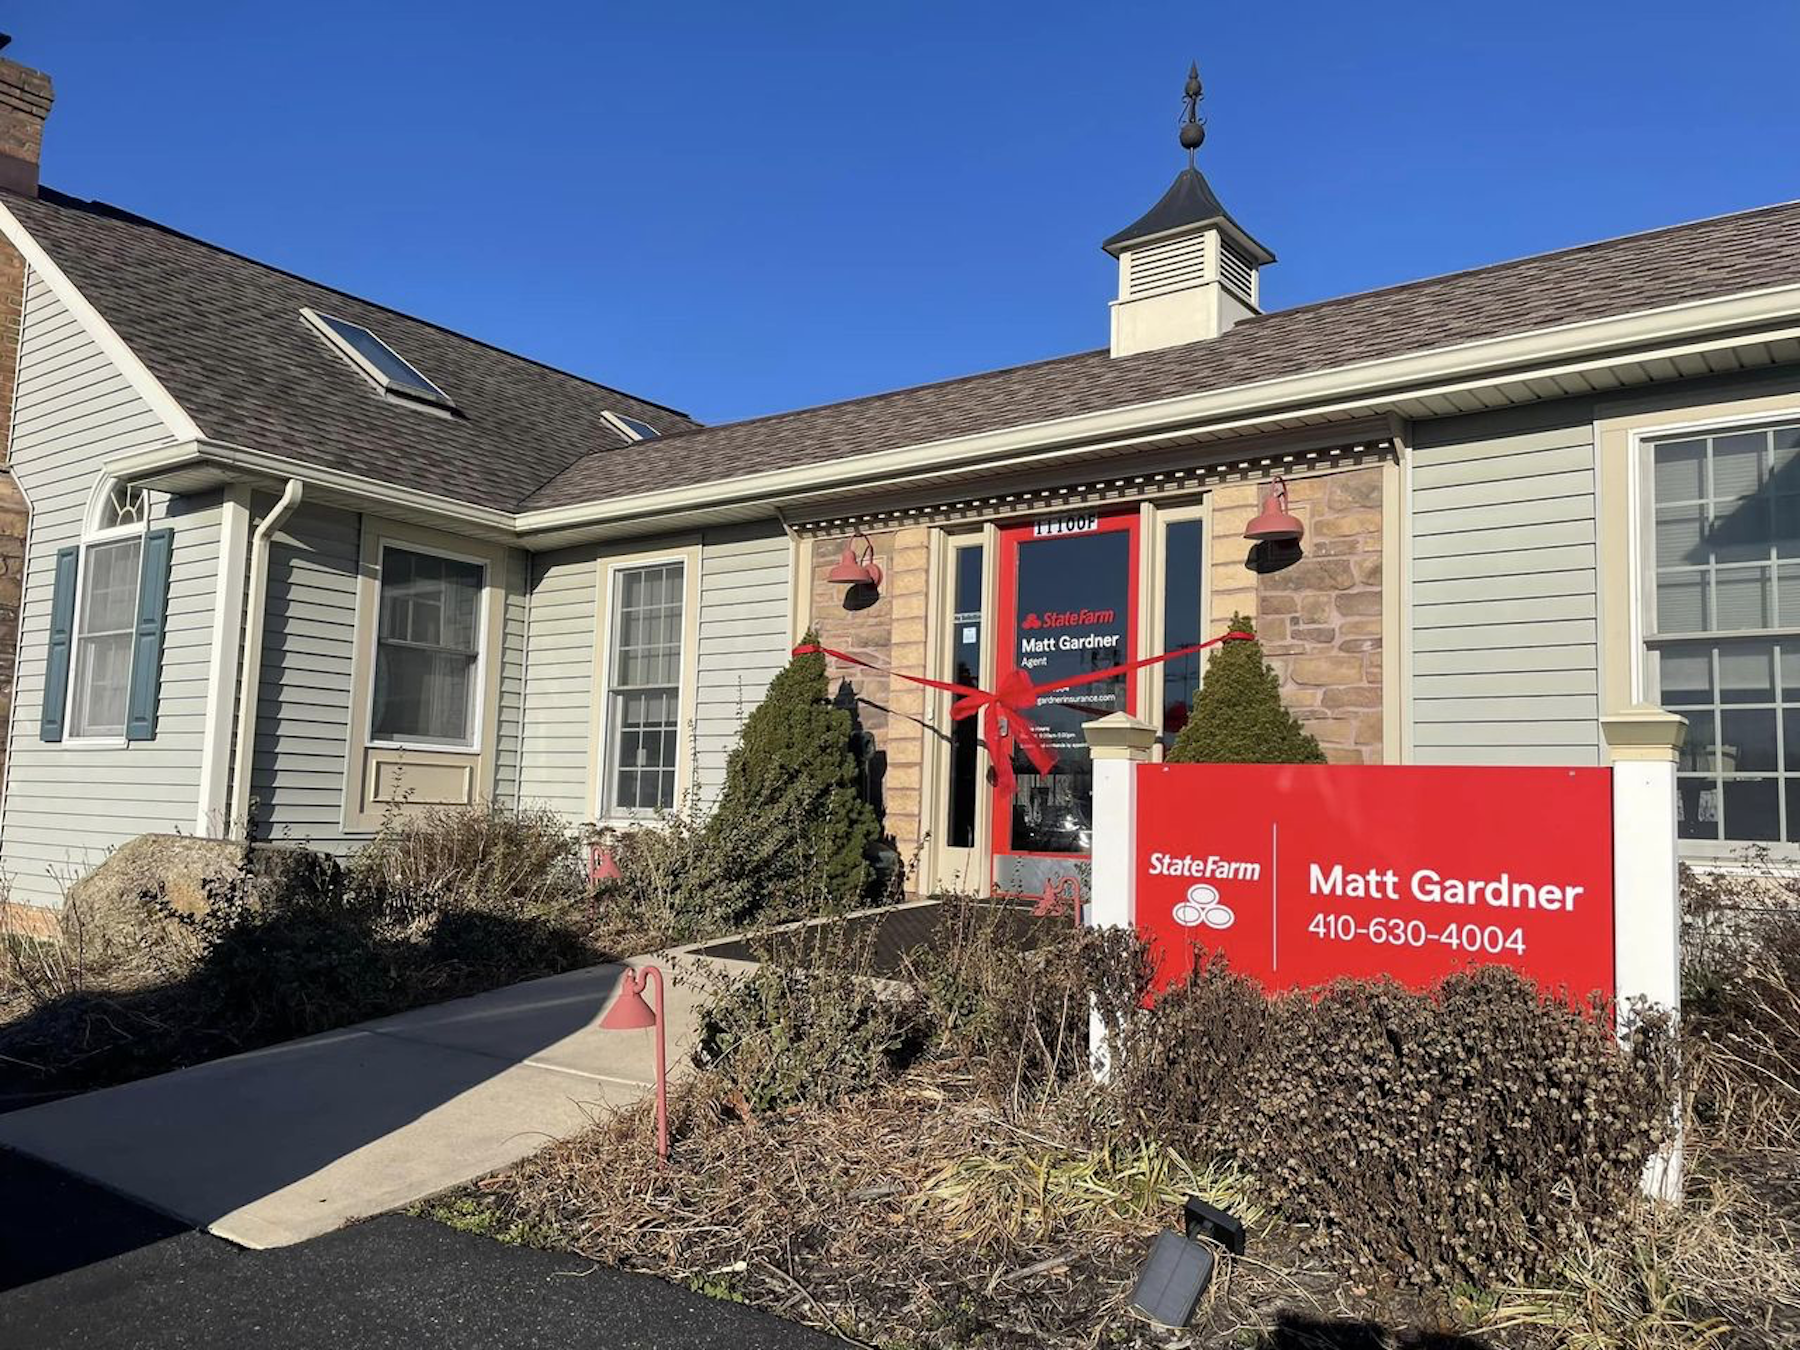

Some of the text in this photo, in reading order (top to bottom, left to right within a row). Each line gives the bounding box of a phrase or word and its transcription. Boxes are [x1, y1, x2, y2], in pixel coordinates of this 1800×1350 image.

[1036, 515, 1096, 535] 11100F
[1021, 634, 1120, 653] Matt Gardner
[1021, 656, 1047, 669] Agent
[1036, 694, 1116, 706] gardnerinsurance.com
[1309, 863, 1585, 911] Matt Gardner
[1308, 912, 1526, 956] 410-630-4004
